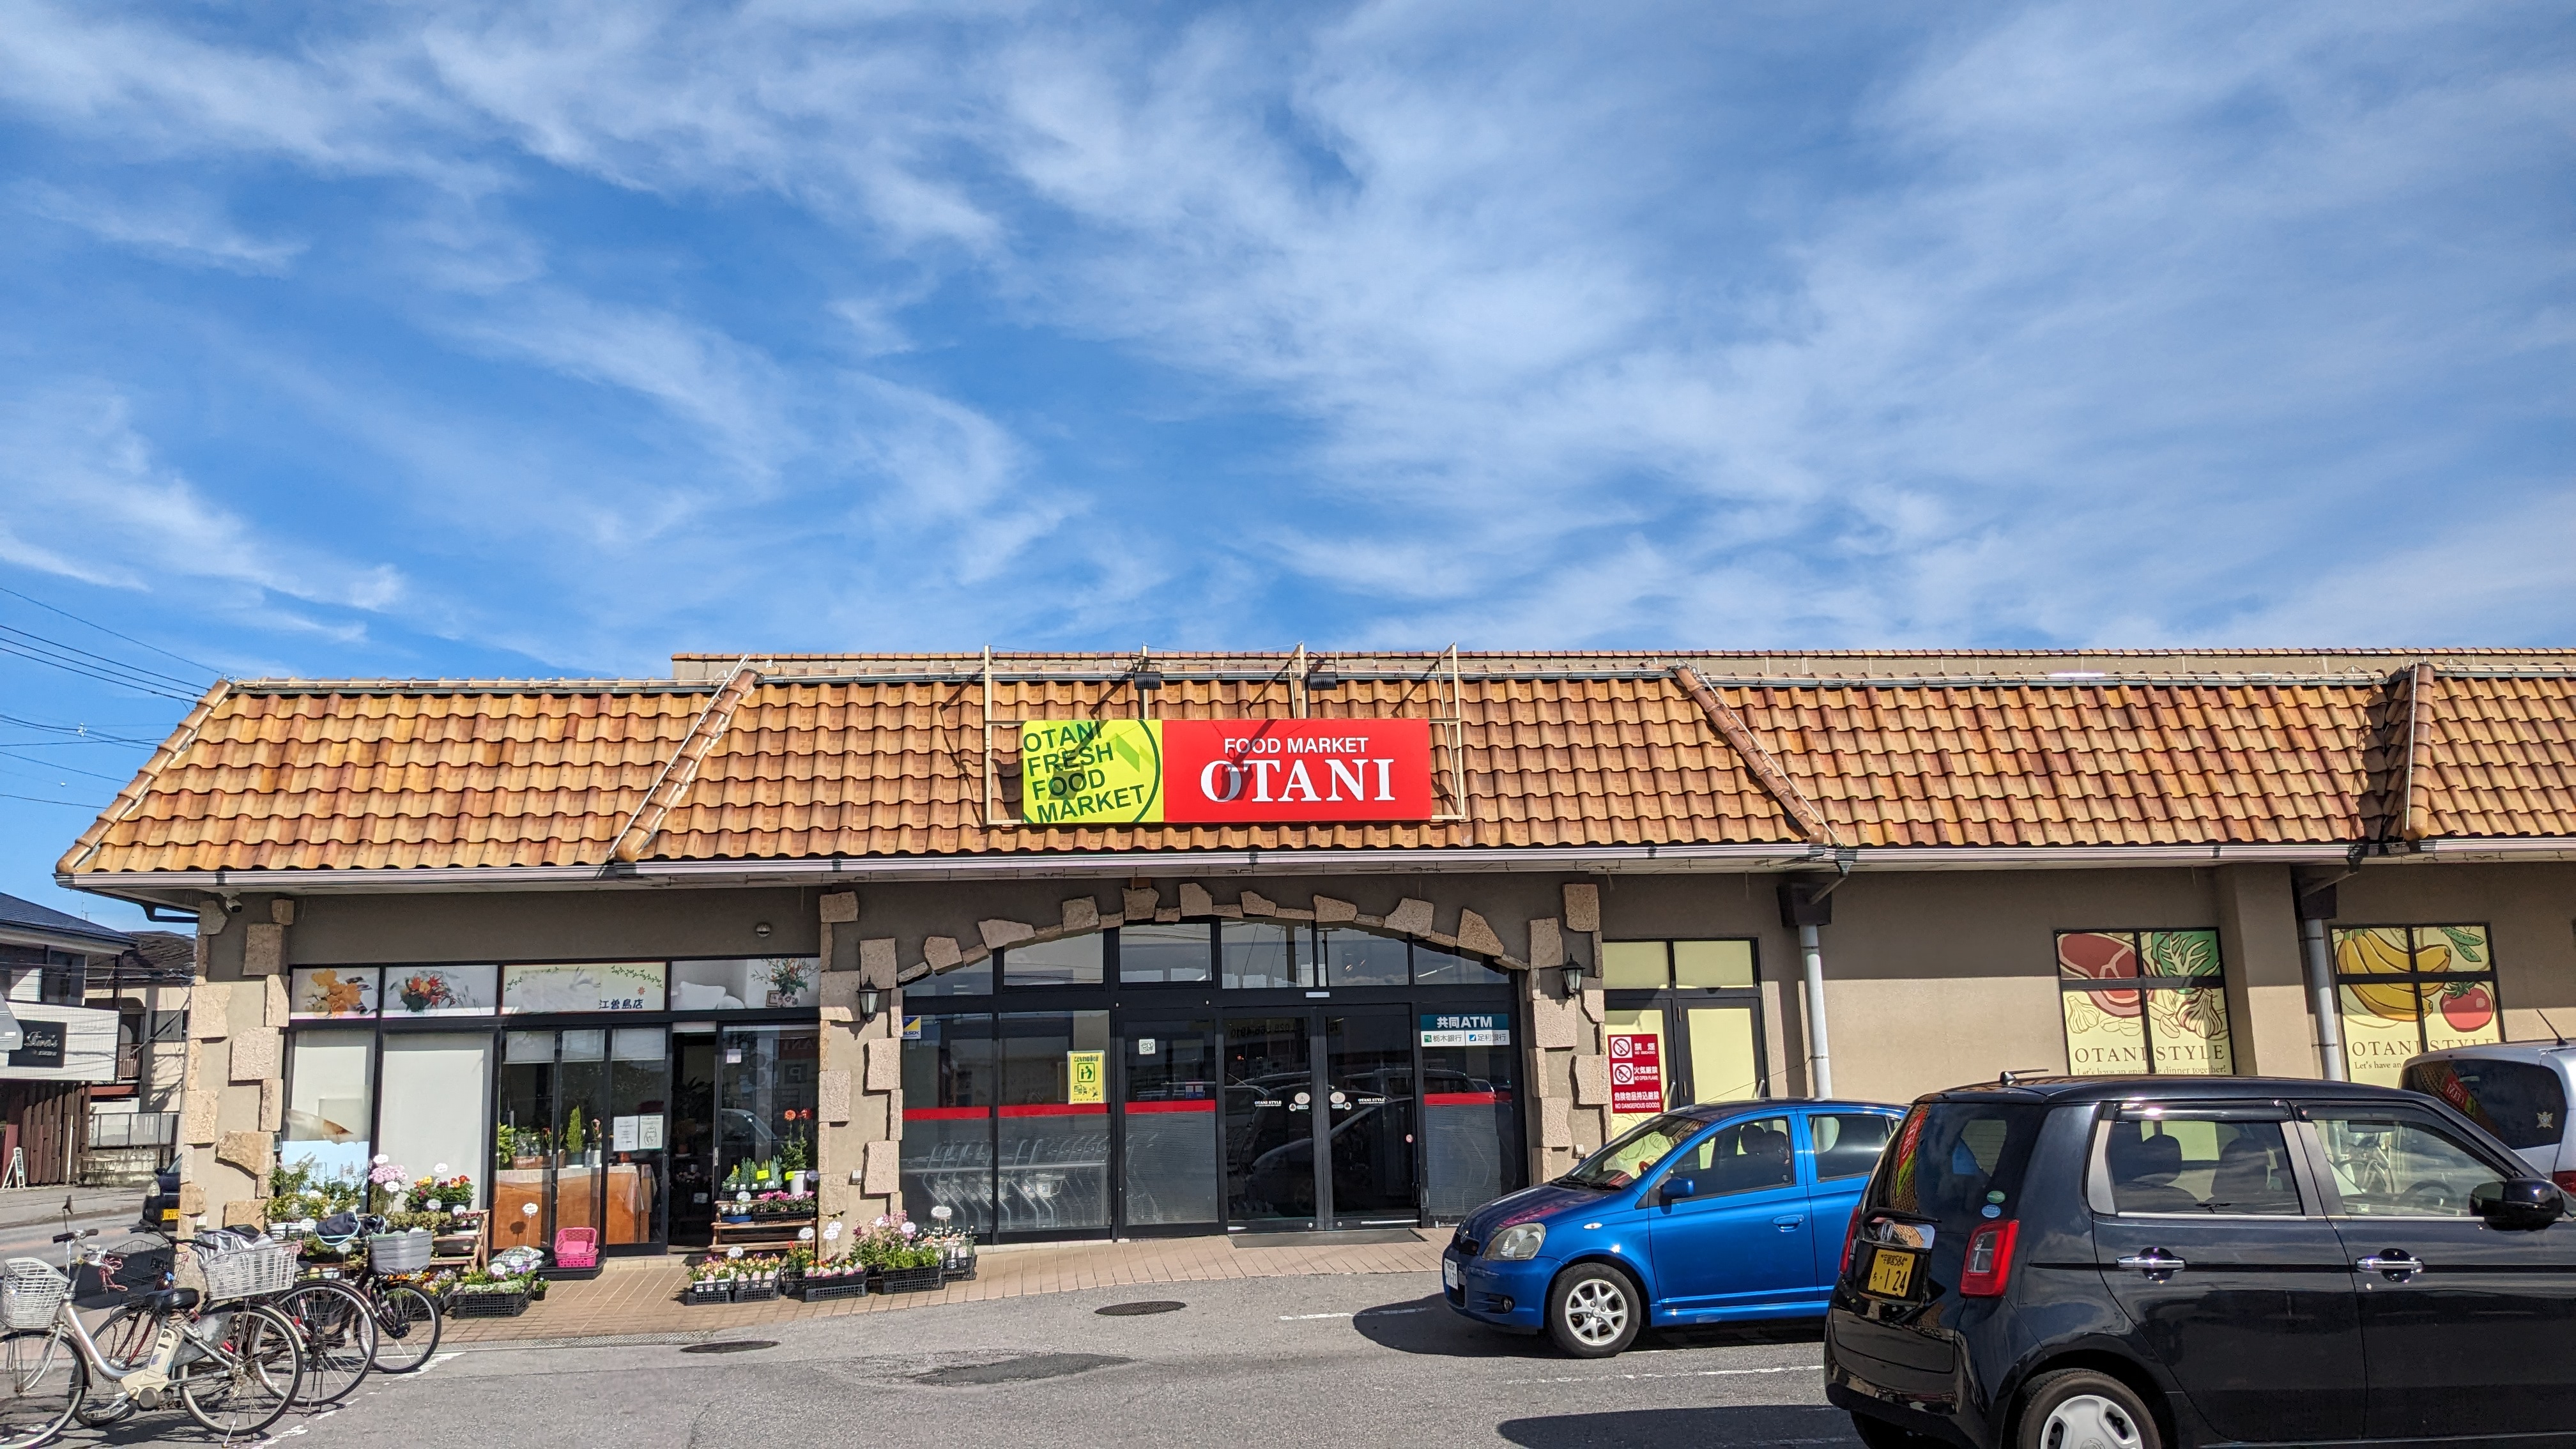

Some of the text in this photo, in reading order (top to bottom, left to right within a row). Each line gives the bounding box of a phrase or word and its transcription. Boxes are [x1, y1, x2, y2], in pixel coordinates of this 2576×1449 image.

[1023, 721, 1102, 752] OTANI
[1224, 737, 1368, 754] FOOD MARKET
[1027, 742, 1114, 776] FRESH
[1032, 769, 1105, 800] FOOD
[1200, 758, 1395, 802] OTANI
[1037, 784, 1145, 823] MARKET
[1437, 1016, 1492, 1029] 共同ATM
[1433, 1034, 1462, 1043] 栃木銀行
[2074, 1045, 2225, 1063] OTANI STYLE
[2352, 1040, 2419, 1057] OTANI
[2354, 1061, 2372, 1069] Let's
[2374, 1061, 2391, 1069] have
